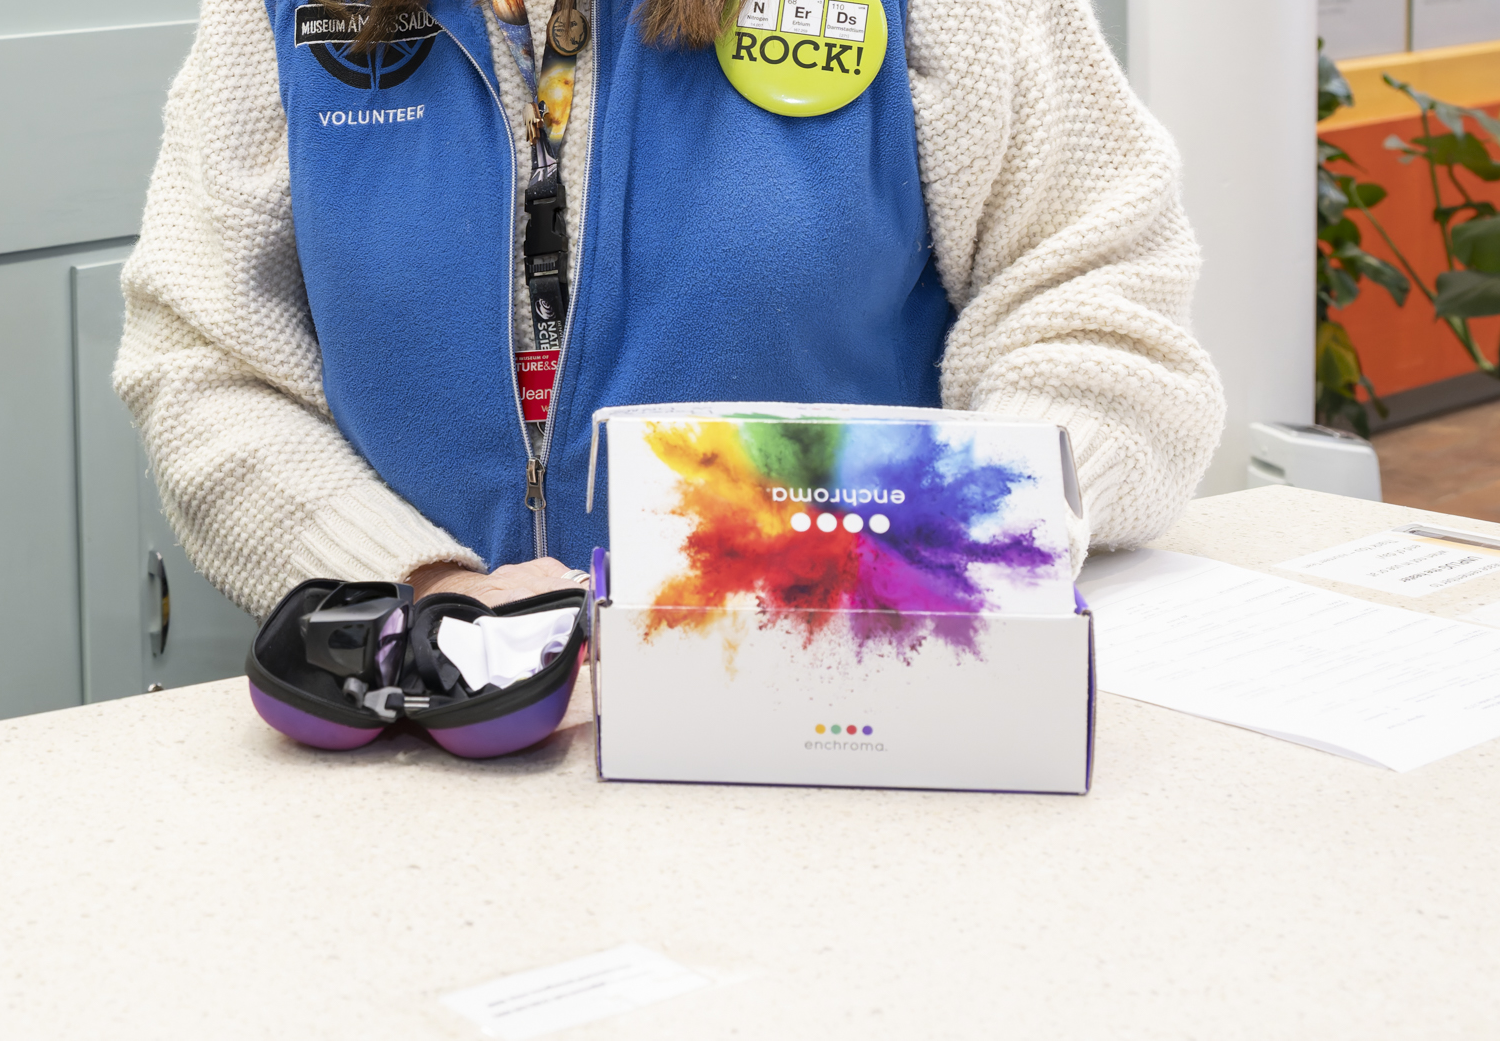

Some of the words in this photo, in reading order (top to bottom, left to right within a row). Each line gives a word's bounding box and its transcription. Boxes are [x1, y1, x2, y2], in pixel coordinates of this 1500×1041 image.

[753, 1, 765, 14] N
[794, 6, 812, 19] Er
[836, 11, 857, 25] Ds
[301, 19, 345, 36] MUSEUM
[731, 31, 864, 76] ROCK!
[318, 104, 425, 127] VOLUNTEER
